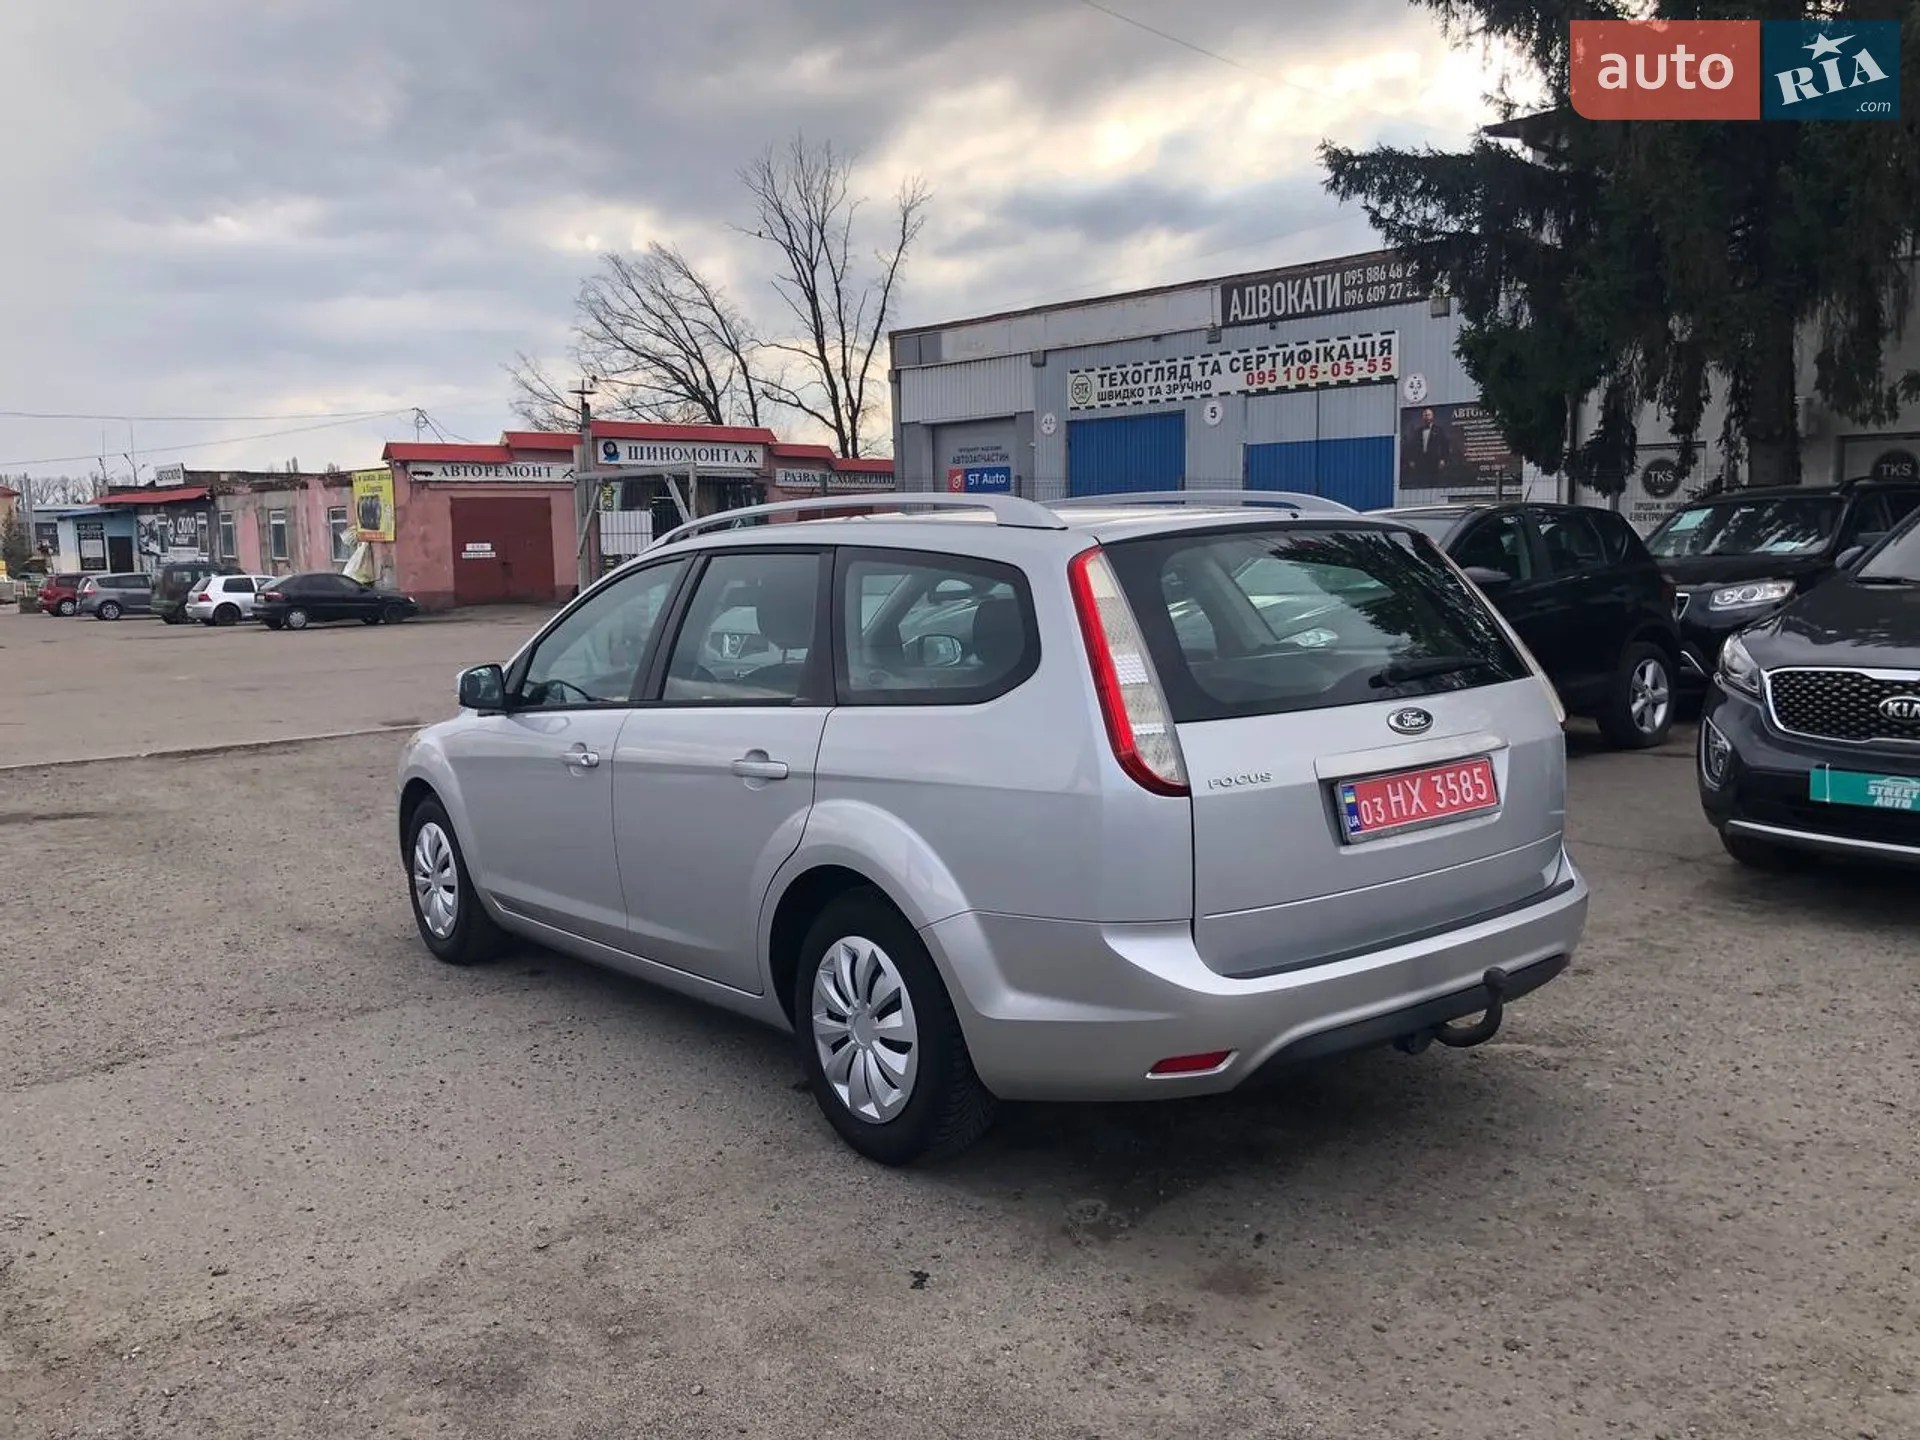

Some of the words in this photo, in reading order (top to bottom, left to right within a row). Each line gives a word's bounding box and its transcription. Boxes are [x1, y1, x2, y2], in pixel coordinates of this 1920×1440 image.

[1344, 269, 1363, 287] 095
[1366, 266, 1386, 283] 886
[1229, 272, 1341, 322] АДВОКАТИ
[1344, 289, 1363, 306] 096
[1366, 285, 1386, 302] 609
[1389, 283, 1403, 299] 27
[1097, 363, 1192, 388] ТЕХОГЛЯД
[1198, 360, 1222, 377] ТА
[1229, 338, 1392, 374] СЕРТИФІКАЦІЯ
[1246, 370, 1277, 386] 095
[1283, 356, 1392, 382] 105-05-55
[1097, 386, 1144, 402] ШВИДКО
[1148, 385, 1162, 396] ТА
[1165, 380, 1212, 395] ЗРУЧНО
[1209, 406, 1217, 419] 5
[628, 445, 758, 463] ШИНОМОНТАЖ
[439, 465, 553, 478] АВТОРЕМОНТ
[1648, 469, 1675, 483] TKS
[1880, 463, 1913, 477] TKS
[968, 473, 980, 486] ST
[982, 472, 1006, 485] Auto
[1402, 711, 1427, 726] Ford
[1207, 772, 1273, 790] FOCUS
[1361, 797, 1385, 825] 03
[1387, 778, 1428, 819] HX
[1431, 767, 1487, 809] 3585
[1867, 785, 1920, 799] STREET
[1873, 796, 1913, 809] AUTO
[1348, 815, 1360, 827] UA
